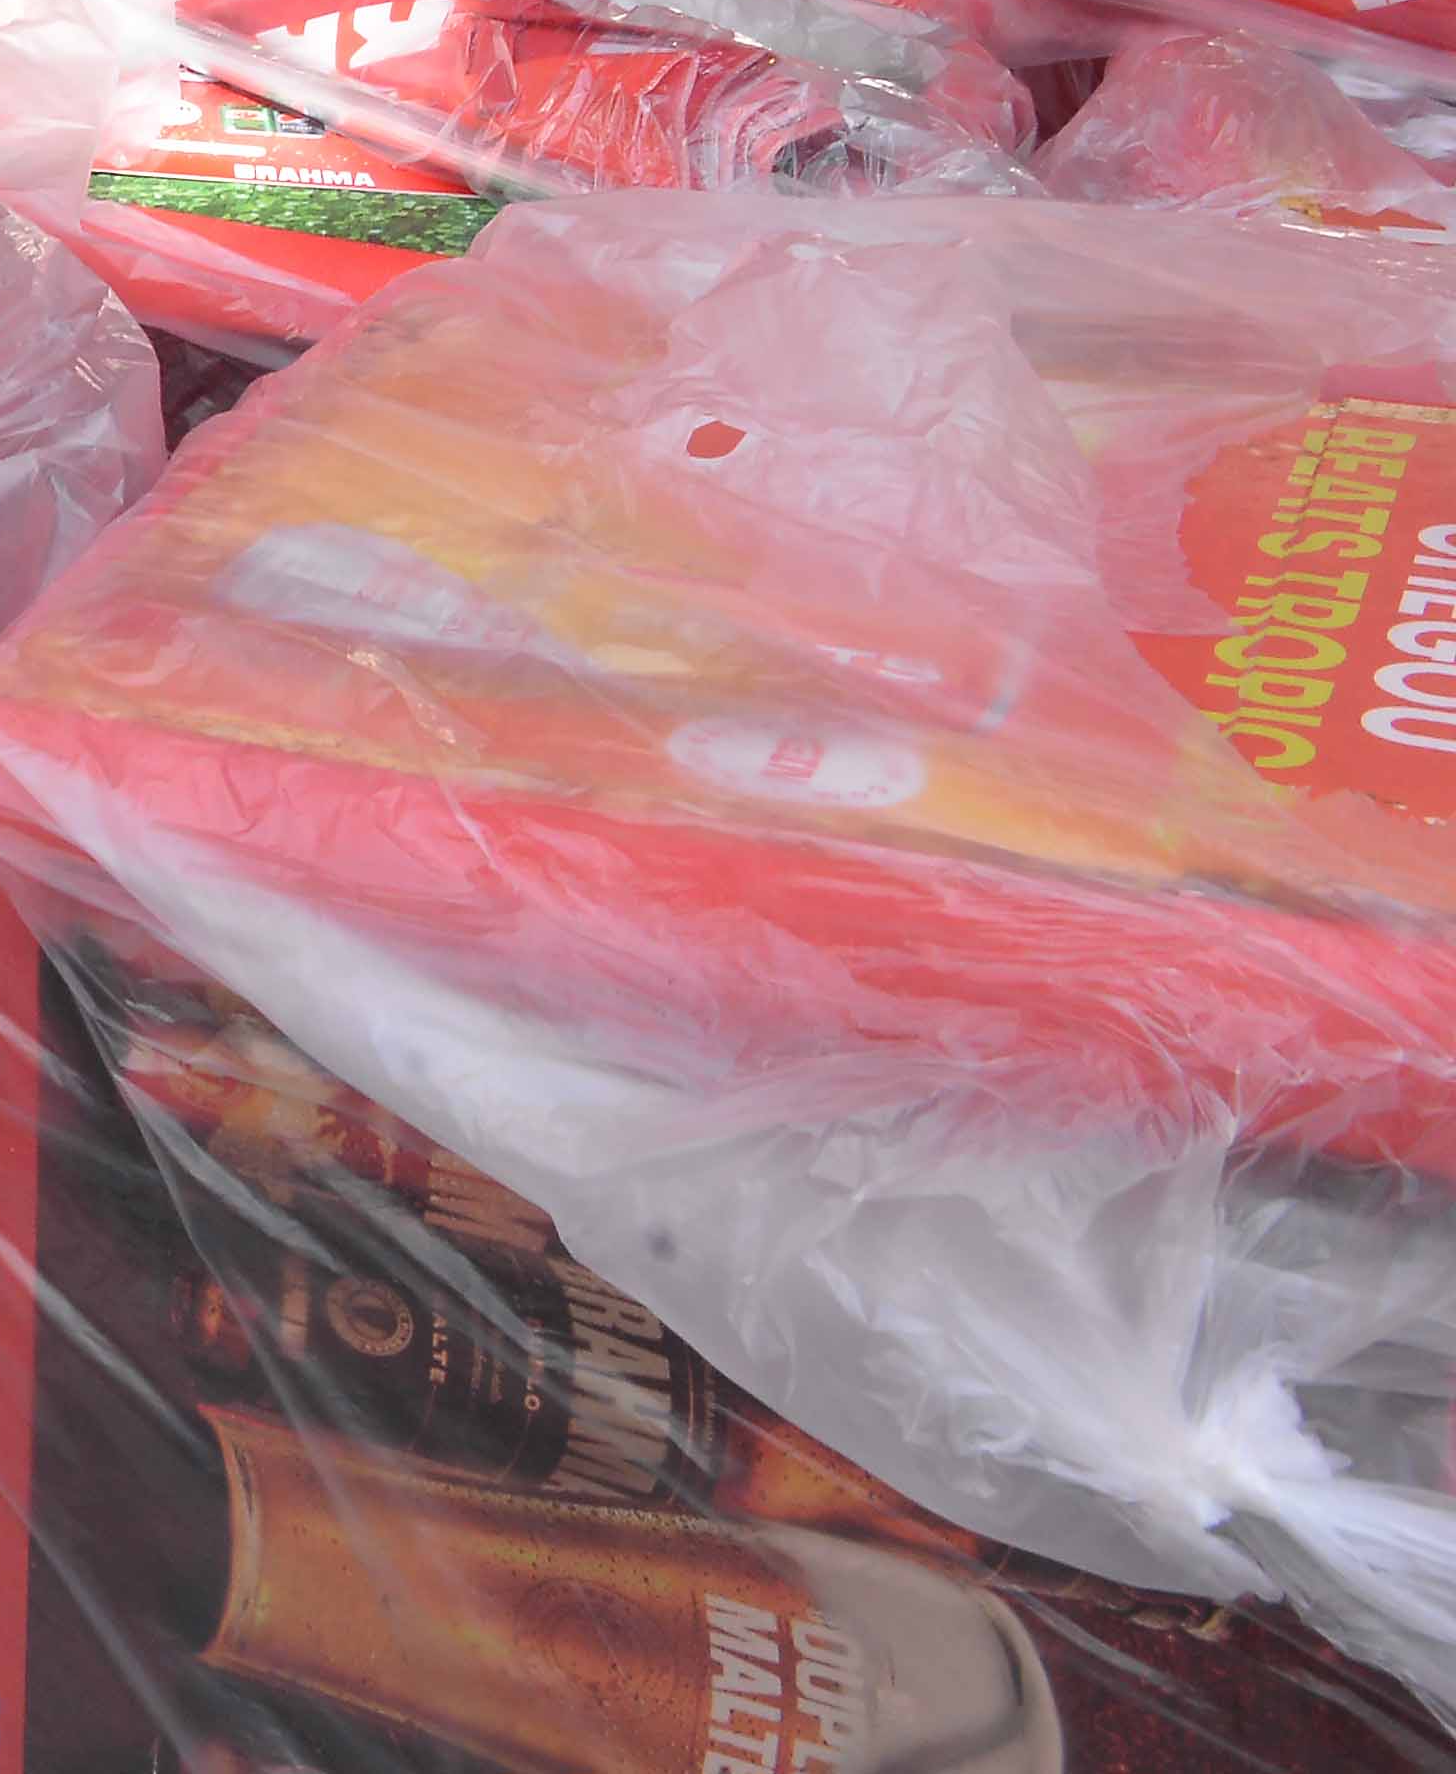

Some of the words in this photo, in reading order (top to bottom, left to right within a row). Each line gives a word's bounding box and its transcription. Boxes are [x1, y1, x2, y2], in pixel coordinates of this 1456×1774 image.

[233, 162, 376, 188] BRAHMA
[1257, 424, 1417, 560] BEATS
[1199, 570, 1370, 769] TROPIC
[429, 1312, 449, 1387] ALTE
